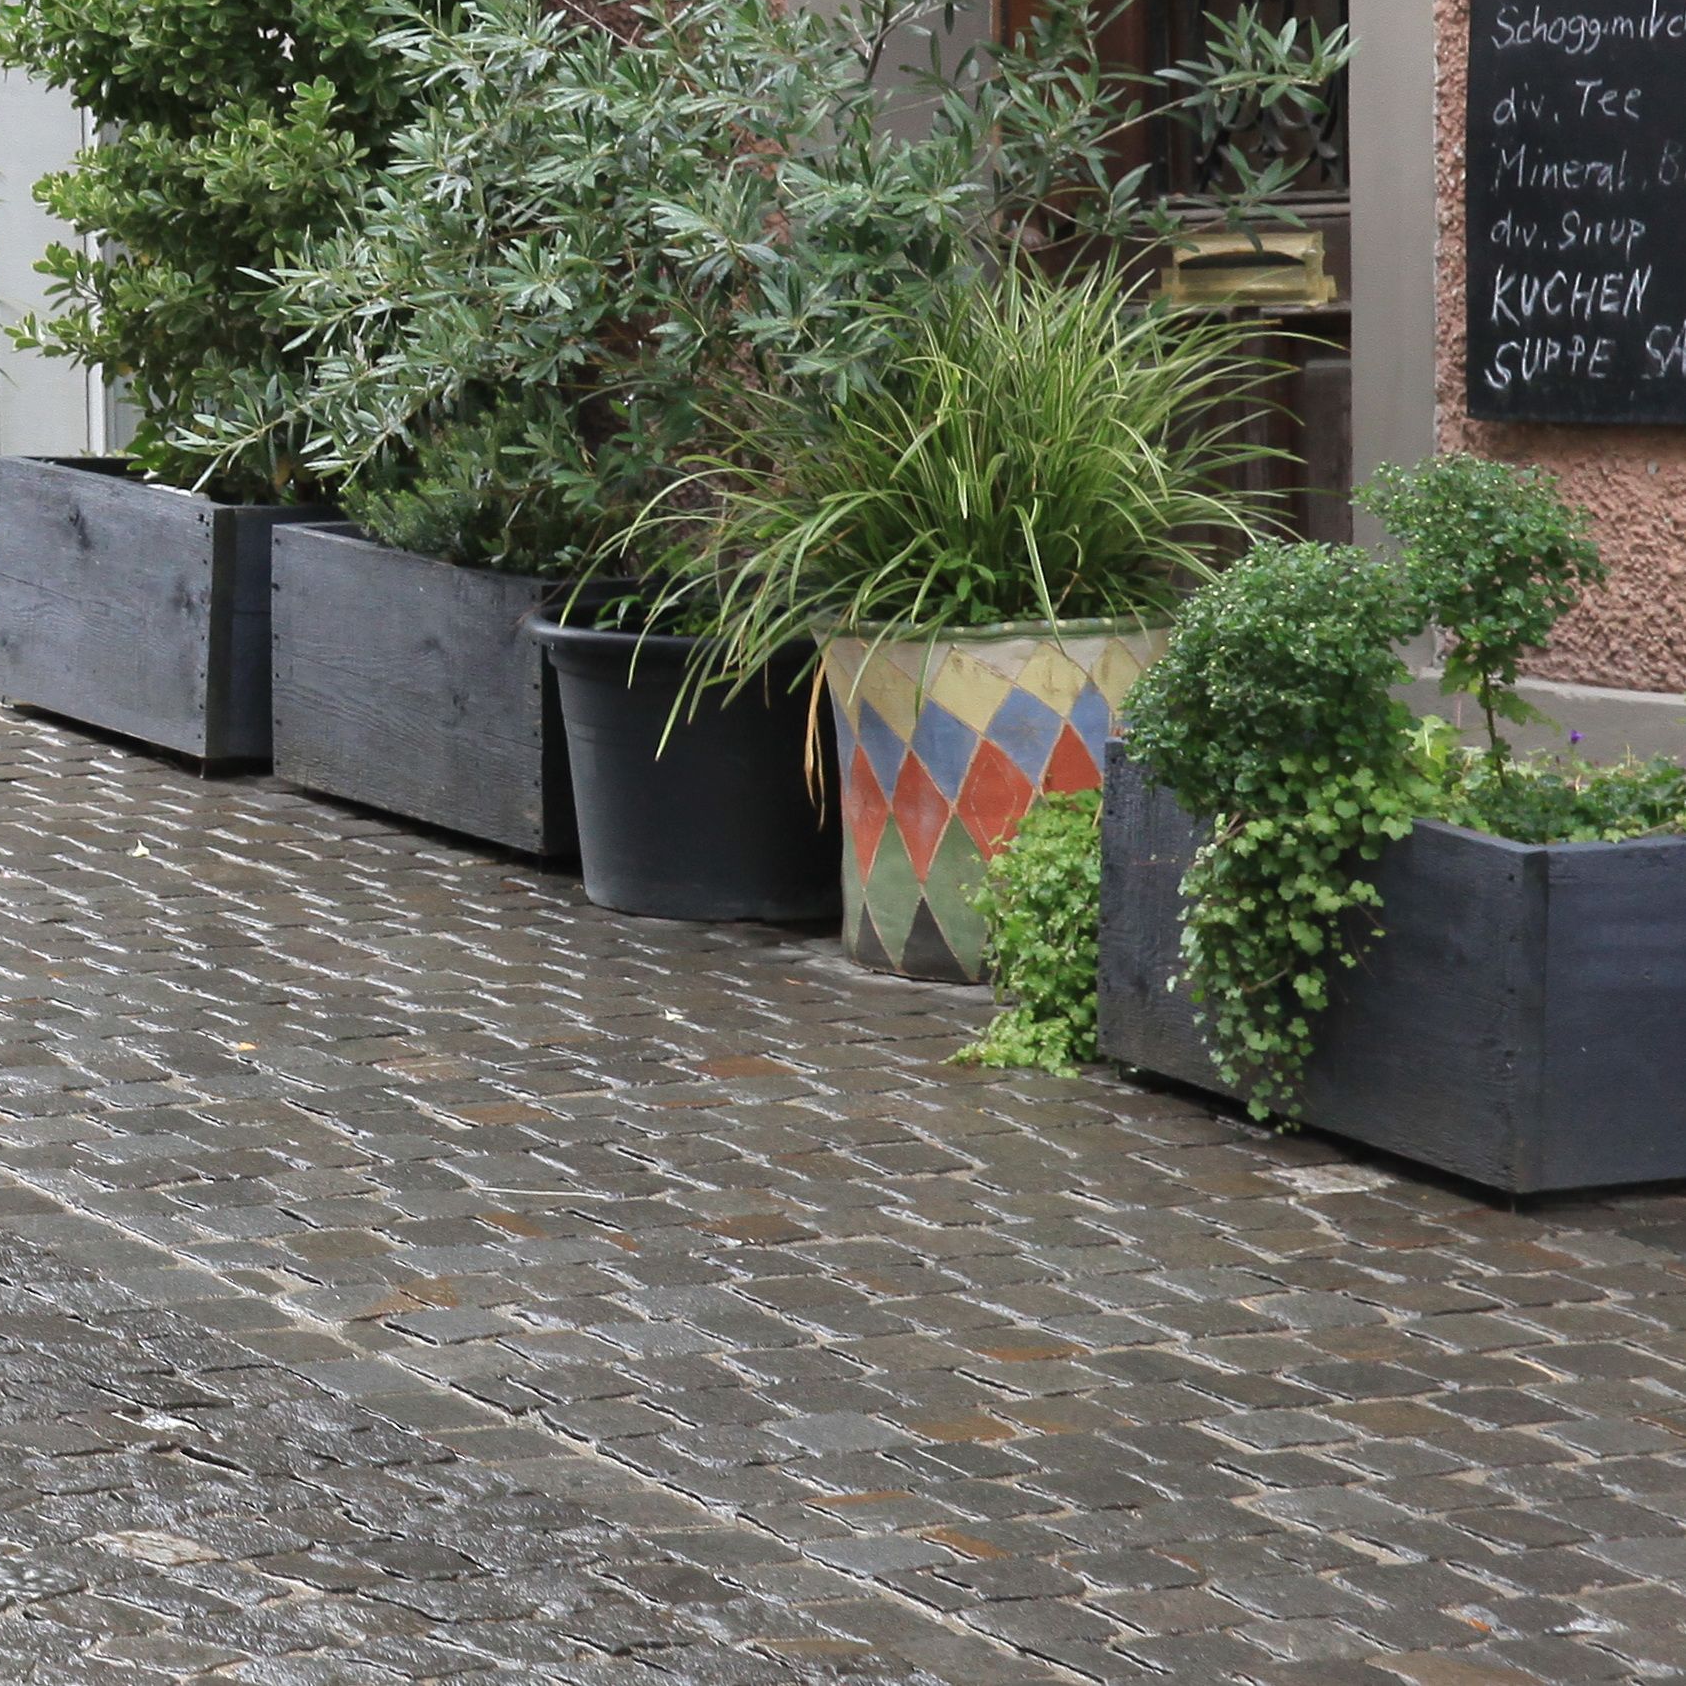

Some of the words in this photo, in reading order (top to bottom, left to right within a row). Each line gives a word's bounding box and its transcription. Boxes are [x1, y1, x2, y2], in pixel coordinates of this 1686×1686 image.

[1493, 83, 1559, 125] div.
[1575, 78, 1642, 120] Tee
[1491, 210, 1547, 249] div.
[1559, 210, 1646, 263] Sirup
[1491, 264, 1652, 327] KUCHEN
[1484, 334, 1616, 390] SUPPE
